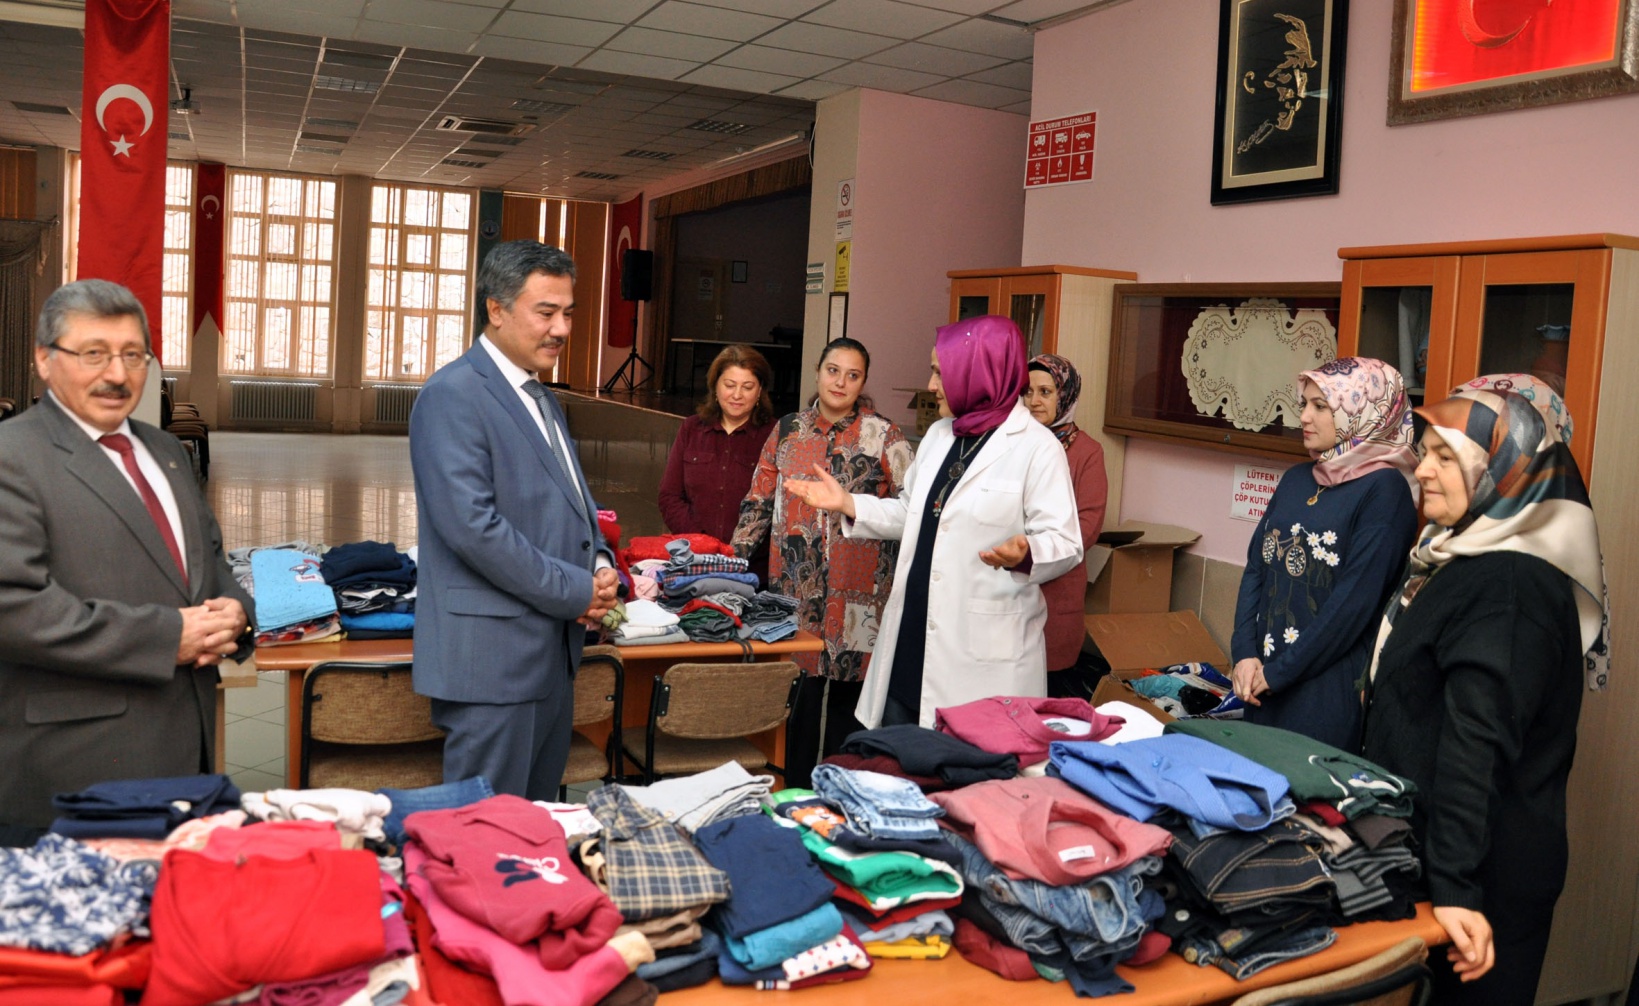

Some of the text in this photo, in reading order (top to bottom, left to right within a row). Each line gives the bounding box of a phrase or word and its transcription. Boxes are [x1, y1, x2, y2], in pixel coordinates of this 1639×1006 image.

[1247, 470, 1274, 481] LÜTFEN
[1240, 481, 1276, 494] ÇÖPLERİN
[1234, 492, 1248, 502] ÇÖP
